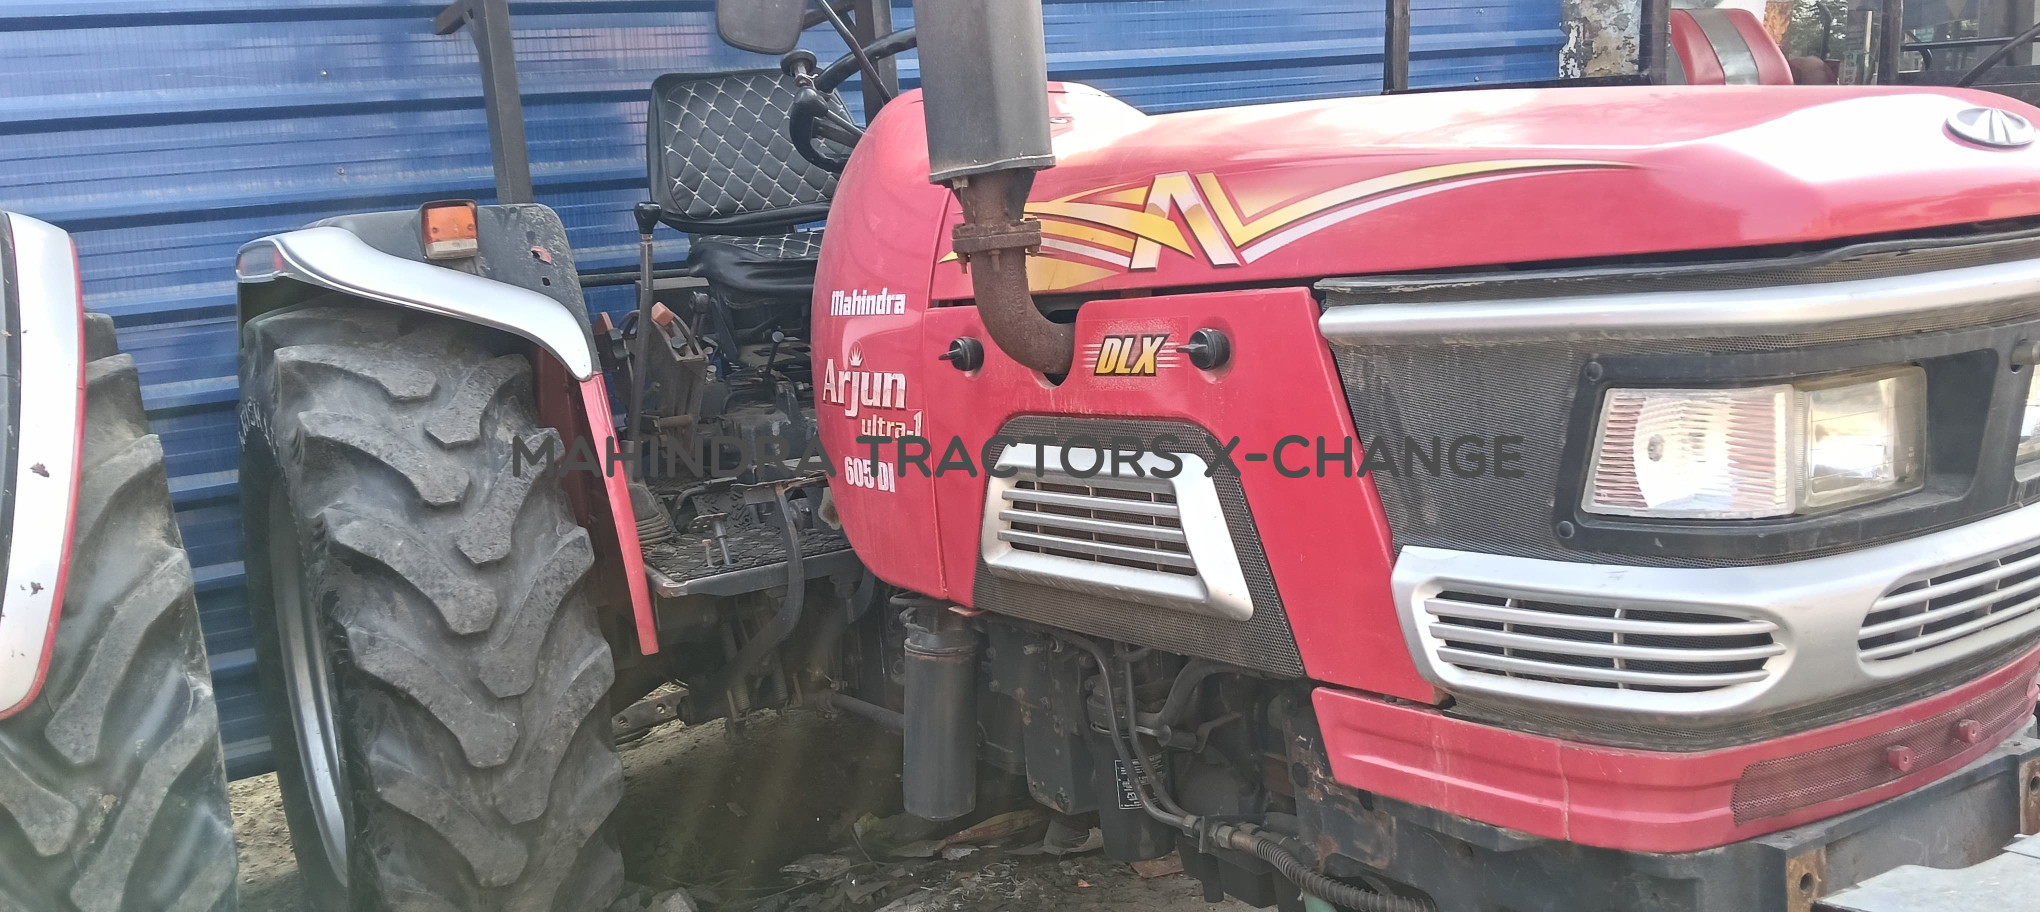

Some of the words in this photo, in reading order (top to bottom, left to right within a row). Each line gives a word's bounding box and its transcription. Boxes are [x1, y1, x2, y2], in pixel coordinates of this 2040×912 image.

[831, 287, 906, 316] Mahindra
[1094, 334, 1169, 376] DLX
[822, 358, 906, 418] Arjun
[861, 411, 923, 438] ultra-1
[844, 456, 875, 489] 605
[878, 462, 896, 493] DI
